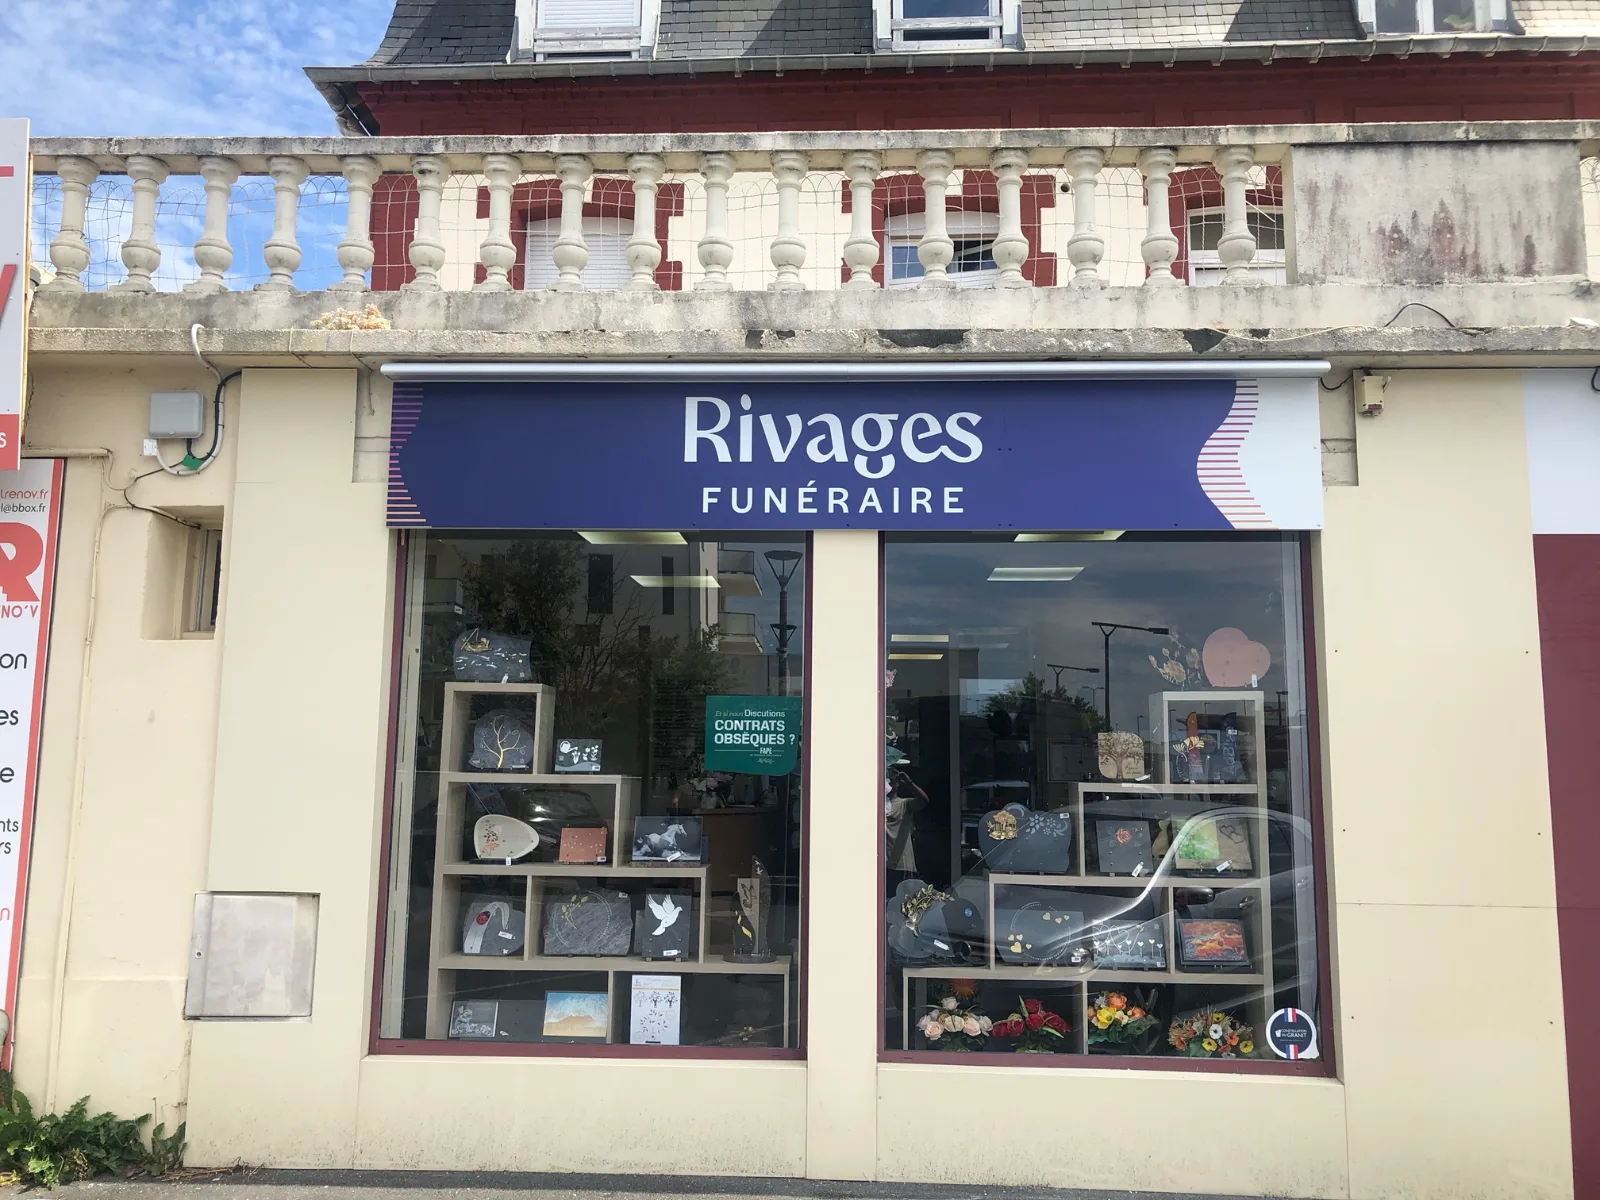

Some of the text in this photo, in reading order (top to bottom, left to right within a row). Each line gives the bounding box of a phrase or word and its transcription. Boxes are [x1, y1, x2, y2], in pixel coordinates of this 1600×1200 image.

[684, 393, 983, 479] Rivages
[702, 480, 965, 514] FUNÉRAIRE
[0, 503, 46, 513] l@bbox.fr
[0, 653, 28, 669] on
[744, 709, 786, 717] Discutions
[714, 719, 786, 731] CONTRATS
[714, 731, 796, 747] OBSÈQUES ?
